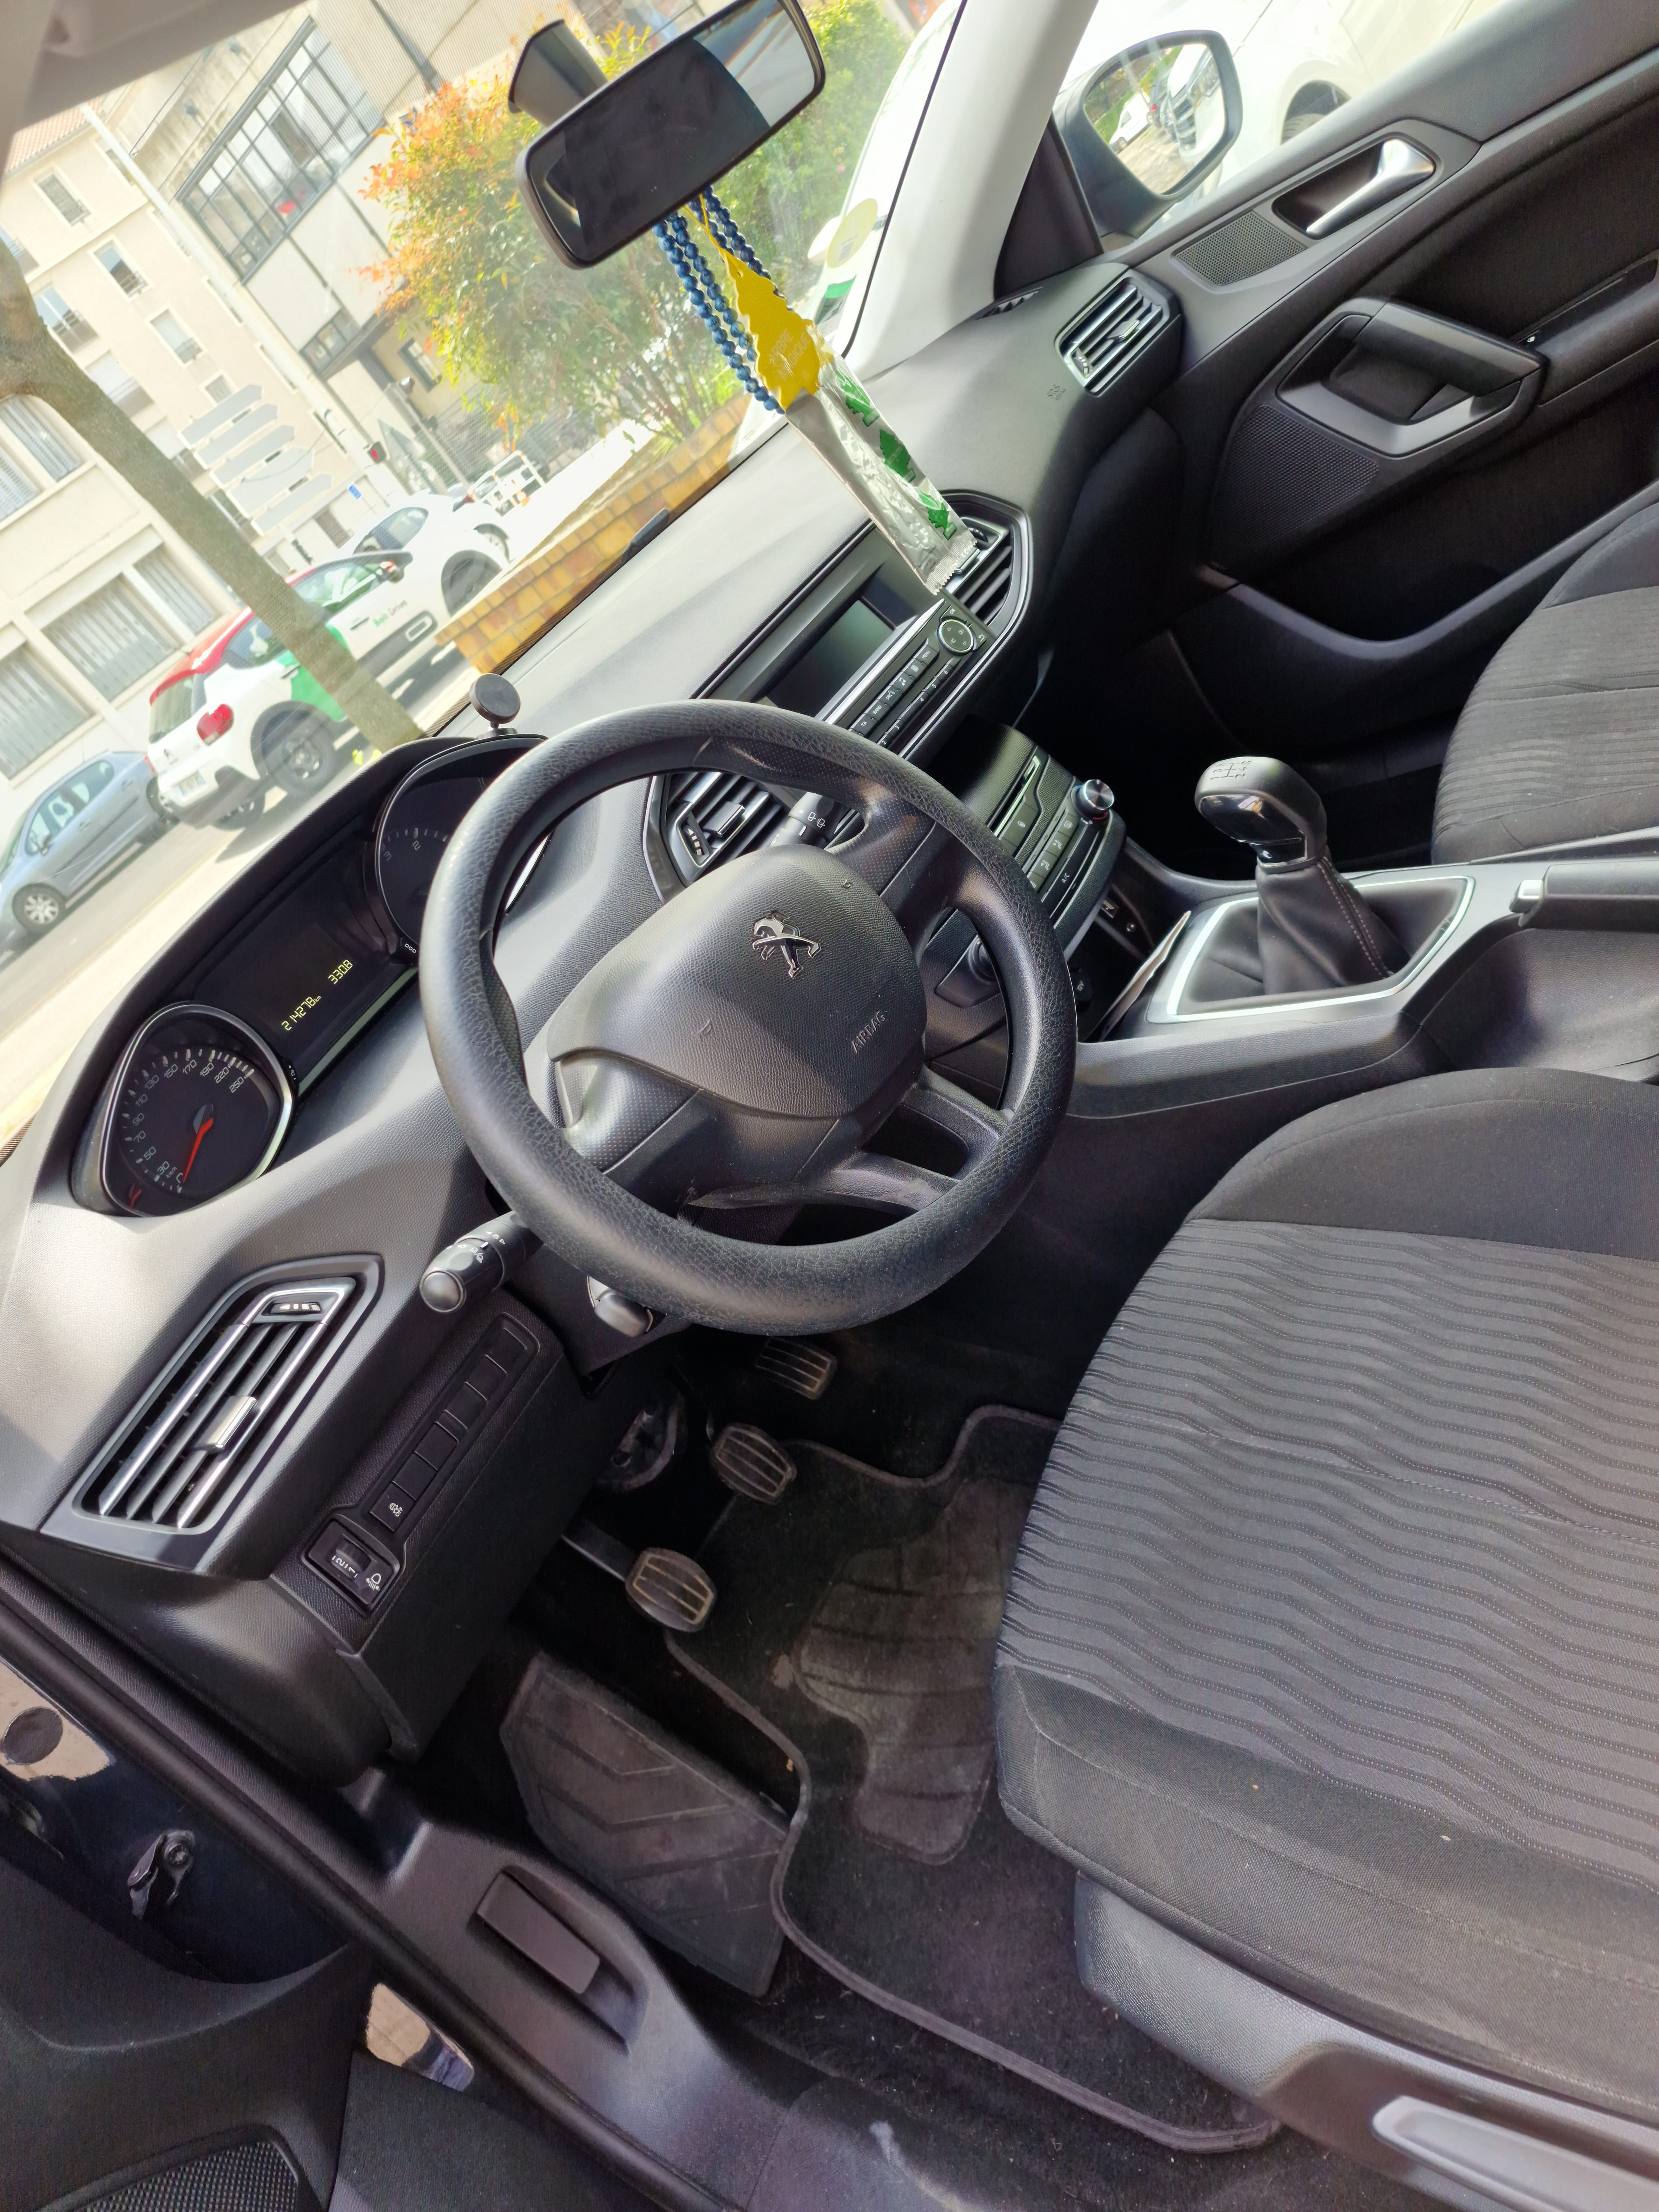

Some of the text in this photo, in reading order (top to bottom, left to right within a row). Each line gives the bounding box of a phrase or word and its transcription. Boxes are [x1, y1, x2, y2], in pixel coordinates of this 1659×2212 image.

[769, 328, 794, 366] ARBRE
[922, 650, 930, 659] MENU
[873, 705, 882, 714] BAND
[384, 841, 421, 861] 3 2
[1061, 873, 1070, 883] A/C
[852, 1011, 885, 1053] AIRBAG
[164, 1064, 178, 1078] 150
[183, 1060, 197, 1074] 170
[200, 1062, 214, 1077] 190
[145, 1075, 159, 1090] 130
[214, 1067, 229, 1084] 220
[229, 1077, 244, 1093] 250
[135, 1094, 148, 1106] 110
[132, 1113, 144, 1126] 90
[134, 1131, 146, 1142] 70
[144, 1146, 156, 1160] 50
[157, 1161, 170, 1175] 30
[166, 1166, 177, 1178] km/h
